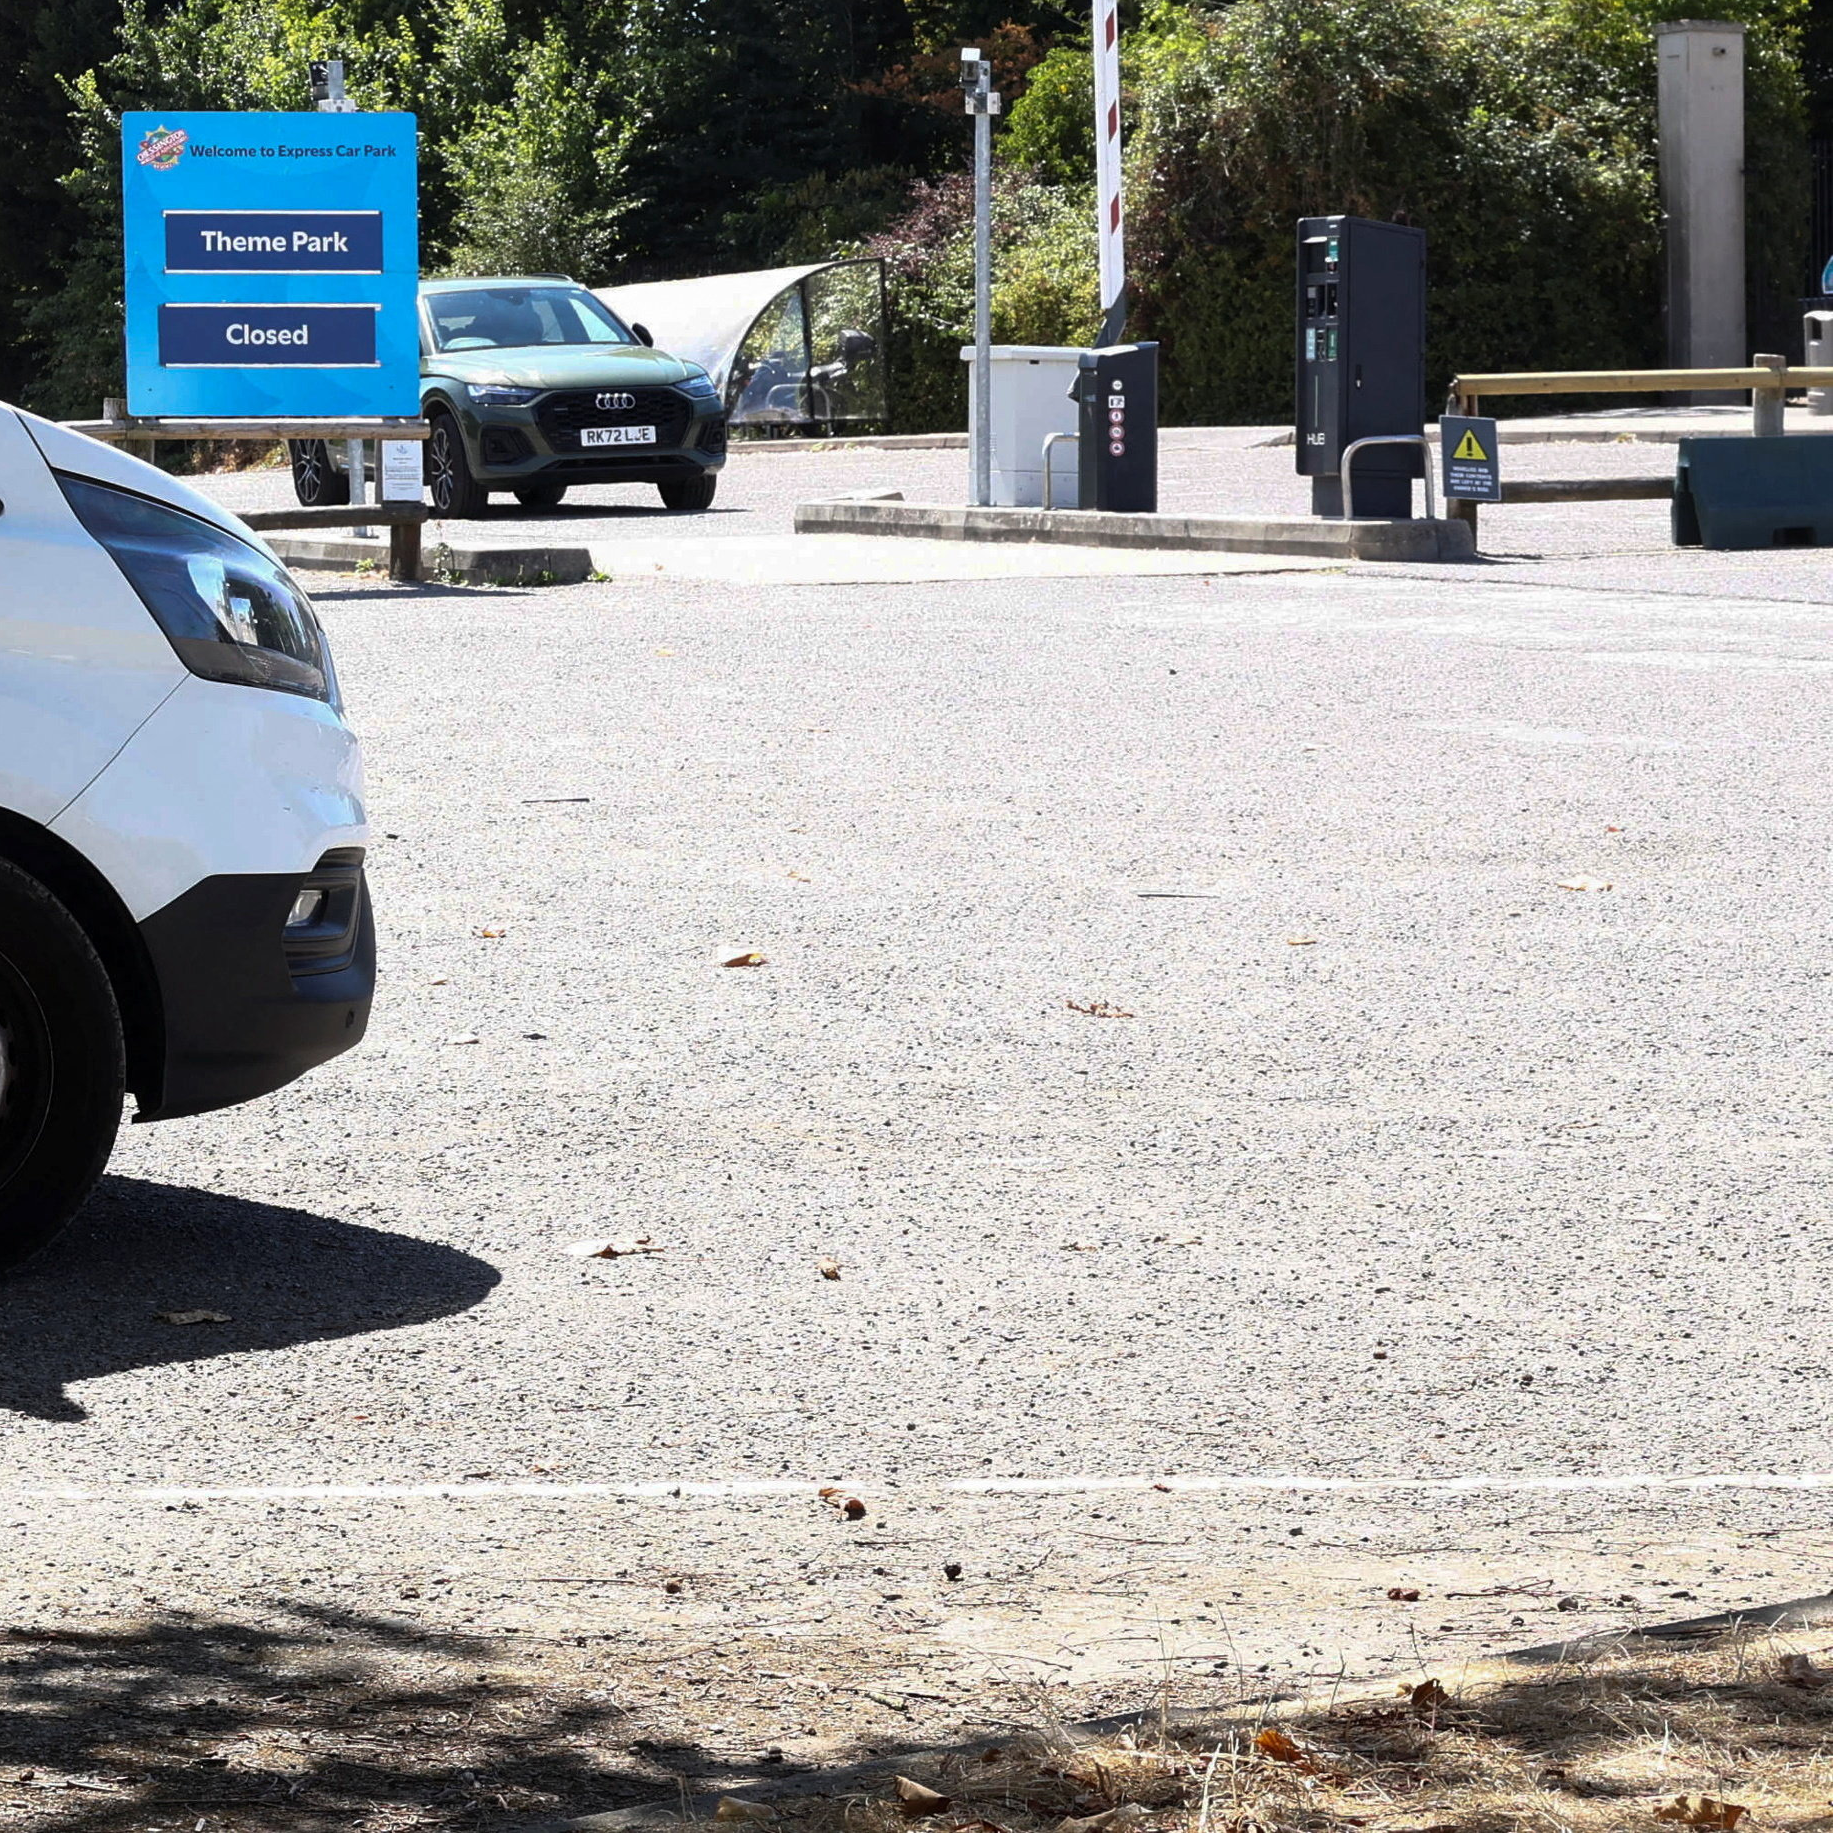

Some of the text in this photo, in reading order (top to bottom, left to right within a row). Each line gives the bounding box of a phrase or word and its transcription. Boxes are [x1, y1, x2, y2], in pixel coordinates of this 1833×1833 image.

[190, 145, 257, 158] Welcome
[260, 146, 276, 158] to
[278, 145, 334, 160] Express
[336, 145, 362, 158] Car
[364, 145, 397, 158] Park
[201, 230, 349, 253] Theme Park
[225, 323, 309, 346] Closed
[586, 429, 622, 444] RK72
[1306, 432, 1325, 445] HUB
